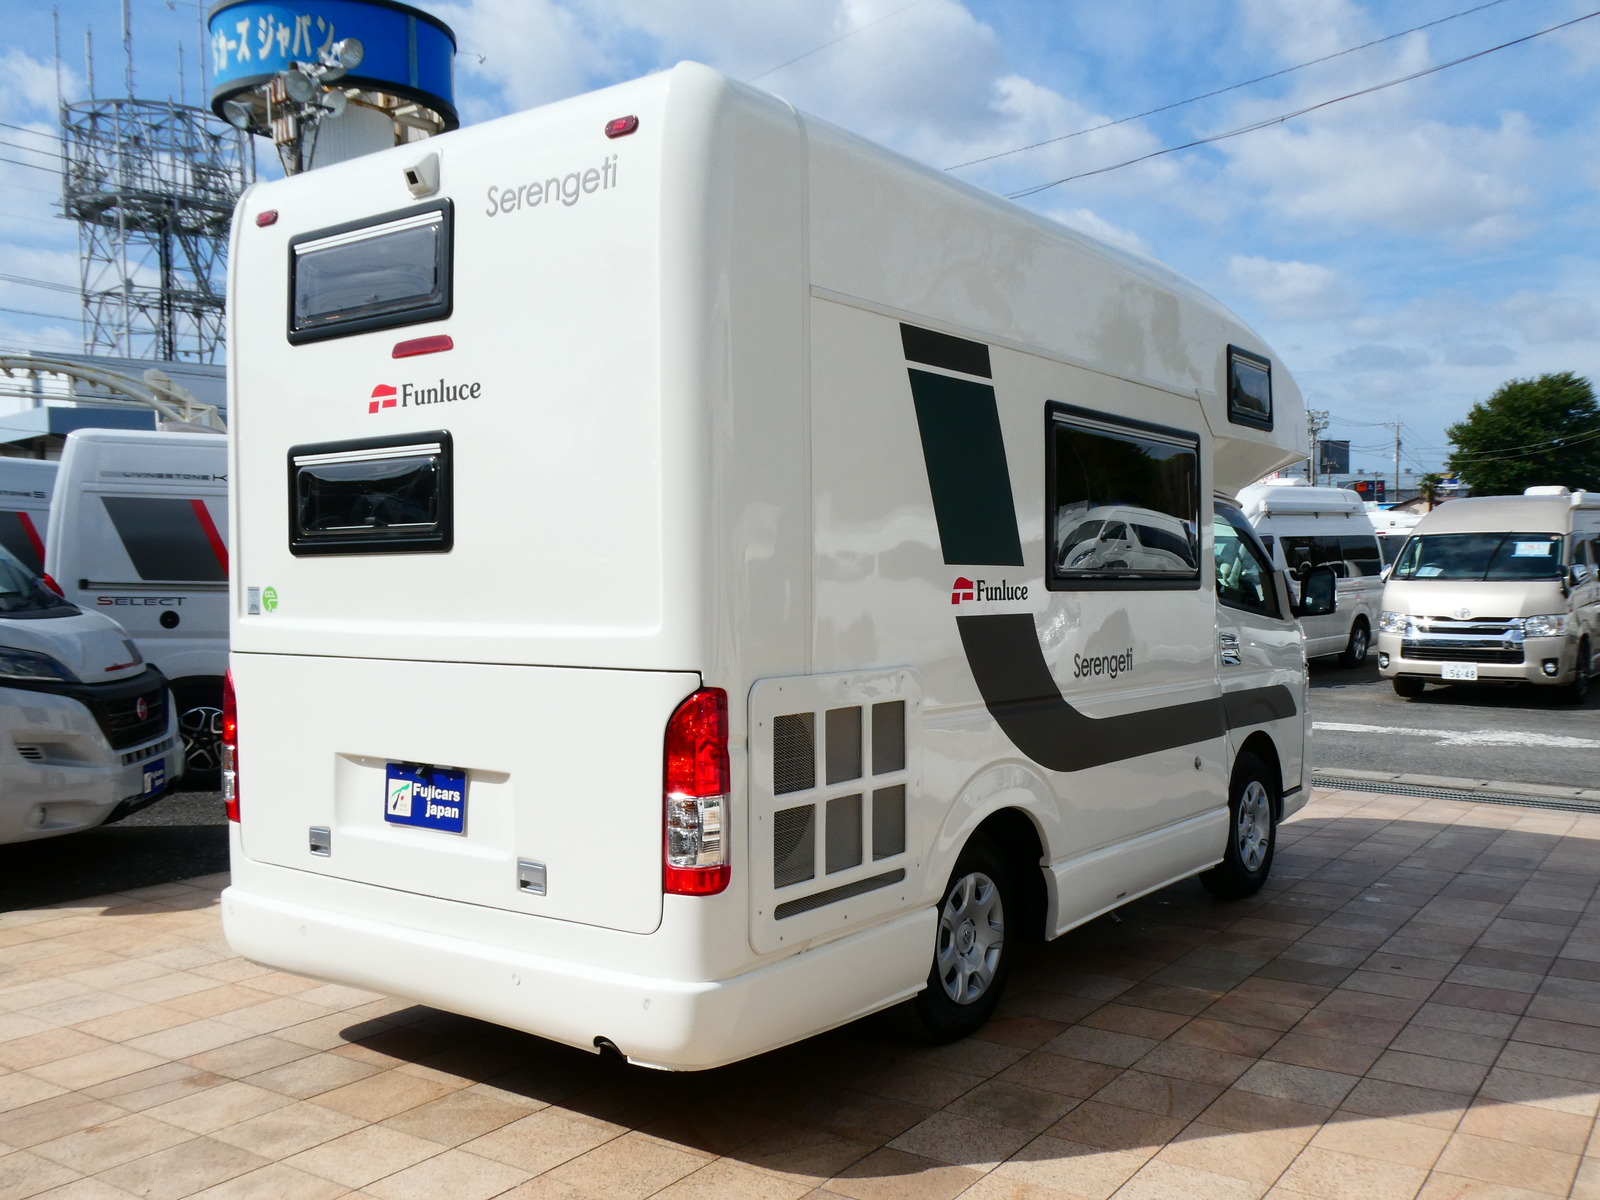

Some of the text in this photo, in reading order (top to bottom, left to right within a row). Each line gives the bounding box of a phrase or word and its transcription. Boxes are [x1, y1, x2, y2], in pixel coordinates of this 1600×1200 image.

[258, 13, 335, 61] ジャパン
[485, 153, 618, 218] Serengeti
[401, 378, 482, 407] Funluce
[122, 472, 210, 481] LIVINGSTONE
[97, 596, 187, 606] SELECT
[976, 579, 1028, 601] Funluce
[1073, 647, 1133, 679] Serengeti
[412, 782, 461, 802] Fujicars
[424, 800, 460, 819] japan
